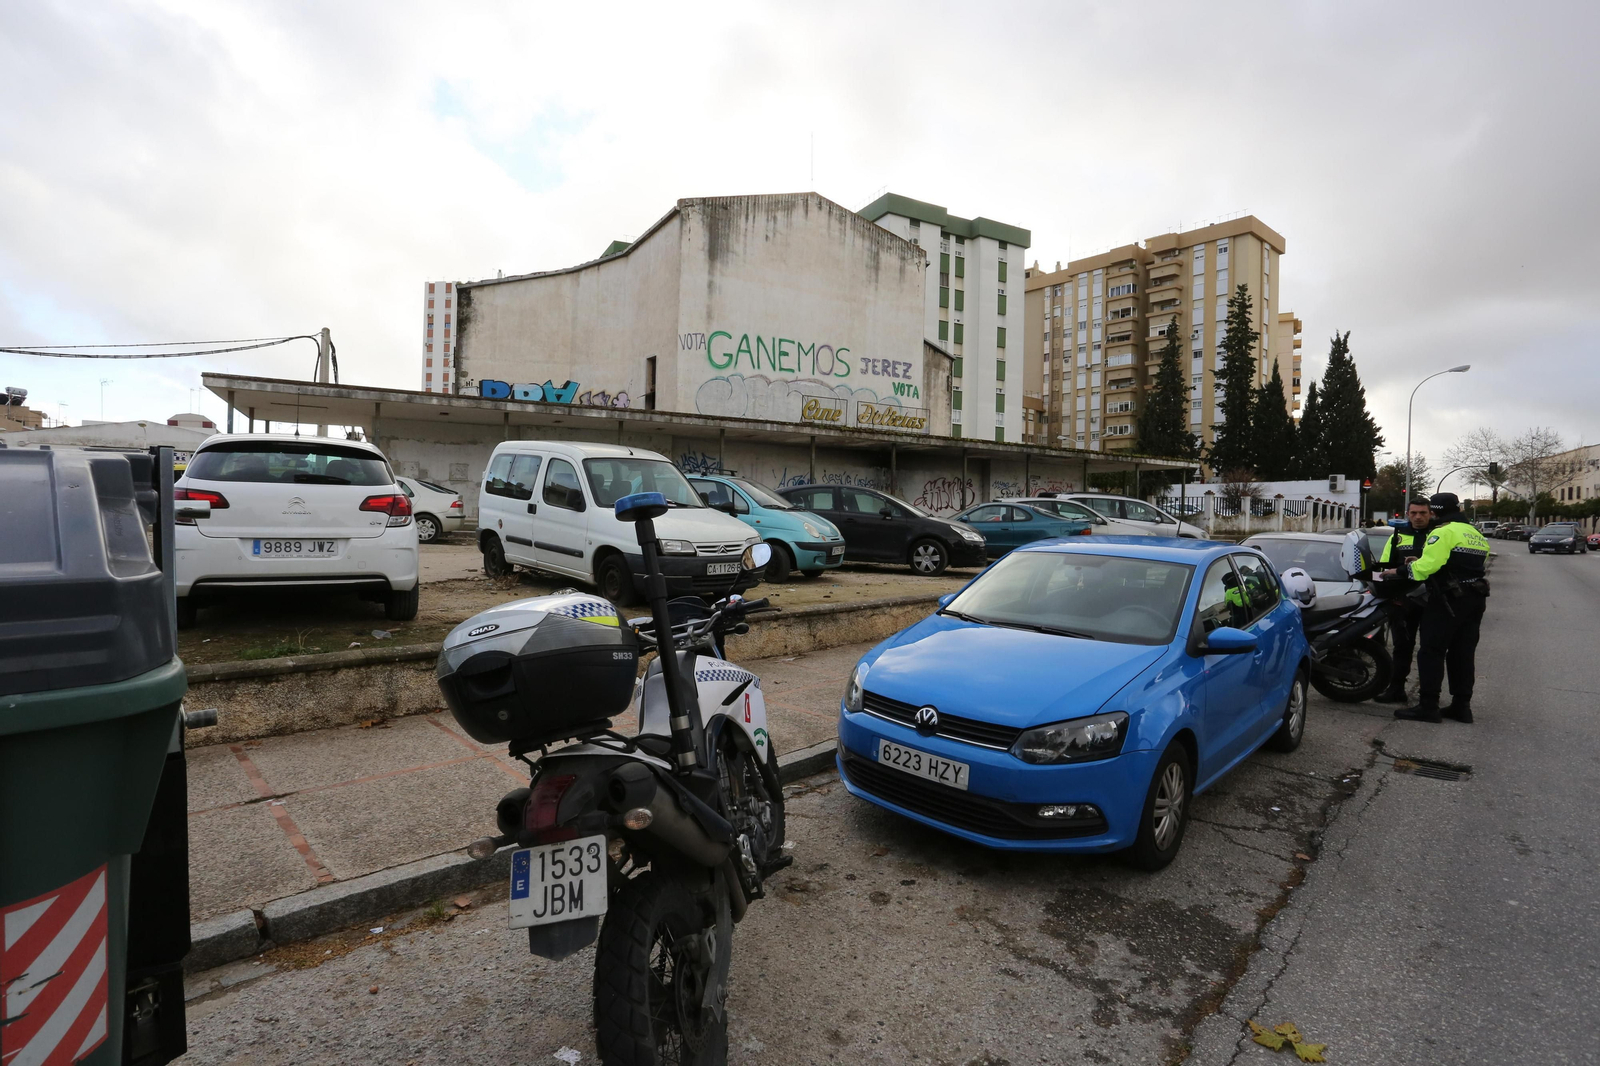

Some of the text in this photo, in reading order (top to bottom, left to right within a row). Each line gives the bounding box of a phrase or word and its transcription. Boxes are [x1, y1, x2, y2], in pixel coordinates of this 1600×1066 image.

[679, 330, 913, 380] VOTA GANEMOS JEREZ
[892, 381, 919, 399] VOTA
[802, 398, 842, 422] Cine
[858, 403, 927, 430] Delicias
[263, 541, 302, 554] 9889
[308, 541, 335, 553] JWZ
[470, 625, 496, 636] SHAD
[612, 652, 633, 660] SH33
[883, 744, 922, 771] 6223
[928, 758, 963, 784] HZY
[539, 842, 601, 882] 1533
[516, 879, 583, 918] E JBM
